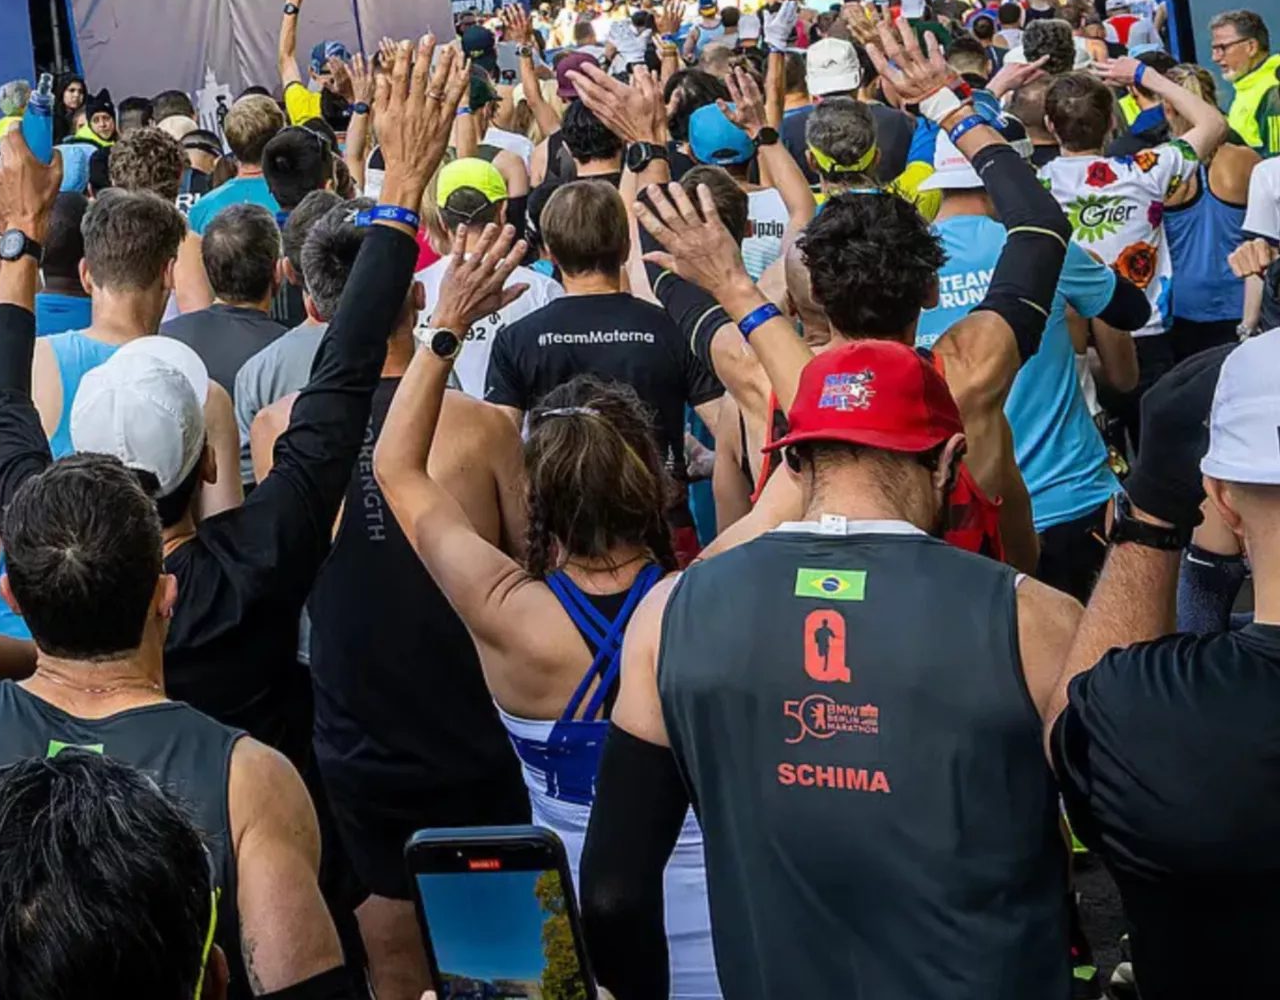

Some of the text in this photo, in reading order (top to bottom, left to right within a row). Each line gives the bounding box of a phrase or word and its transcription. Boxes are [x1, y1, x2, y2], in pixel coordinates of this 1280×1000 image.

[753, 219, 784, 239] ipzig
[538, 329, 655, 347] #TeamMaterna
[827, 704, 858, 717] BMW
[777, 763, 891, 793] SCHIMA
